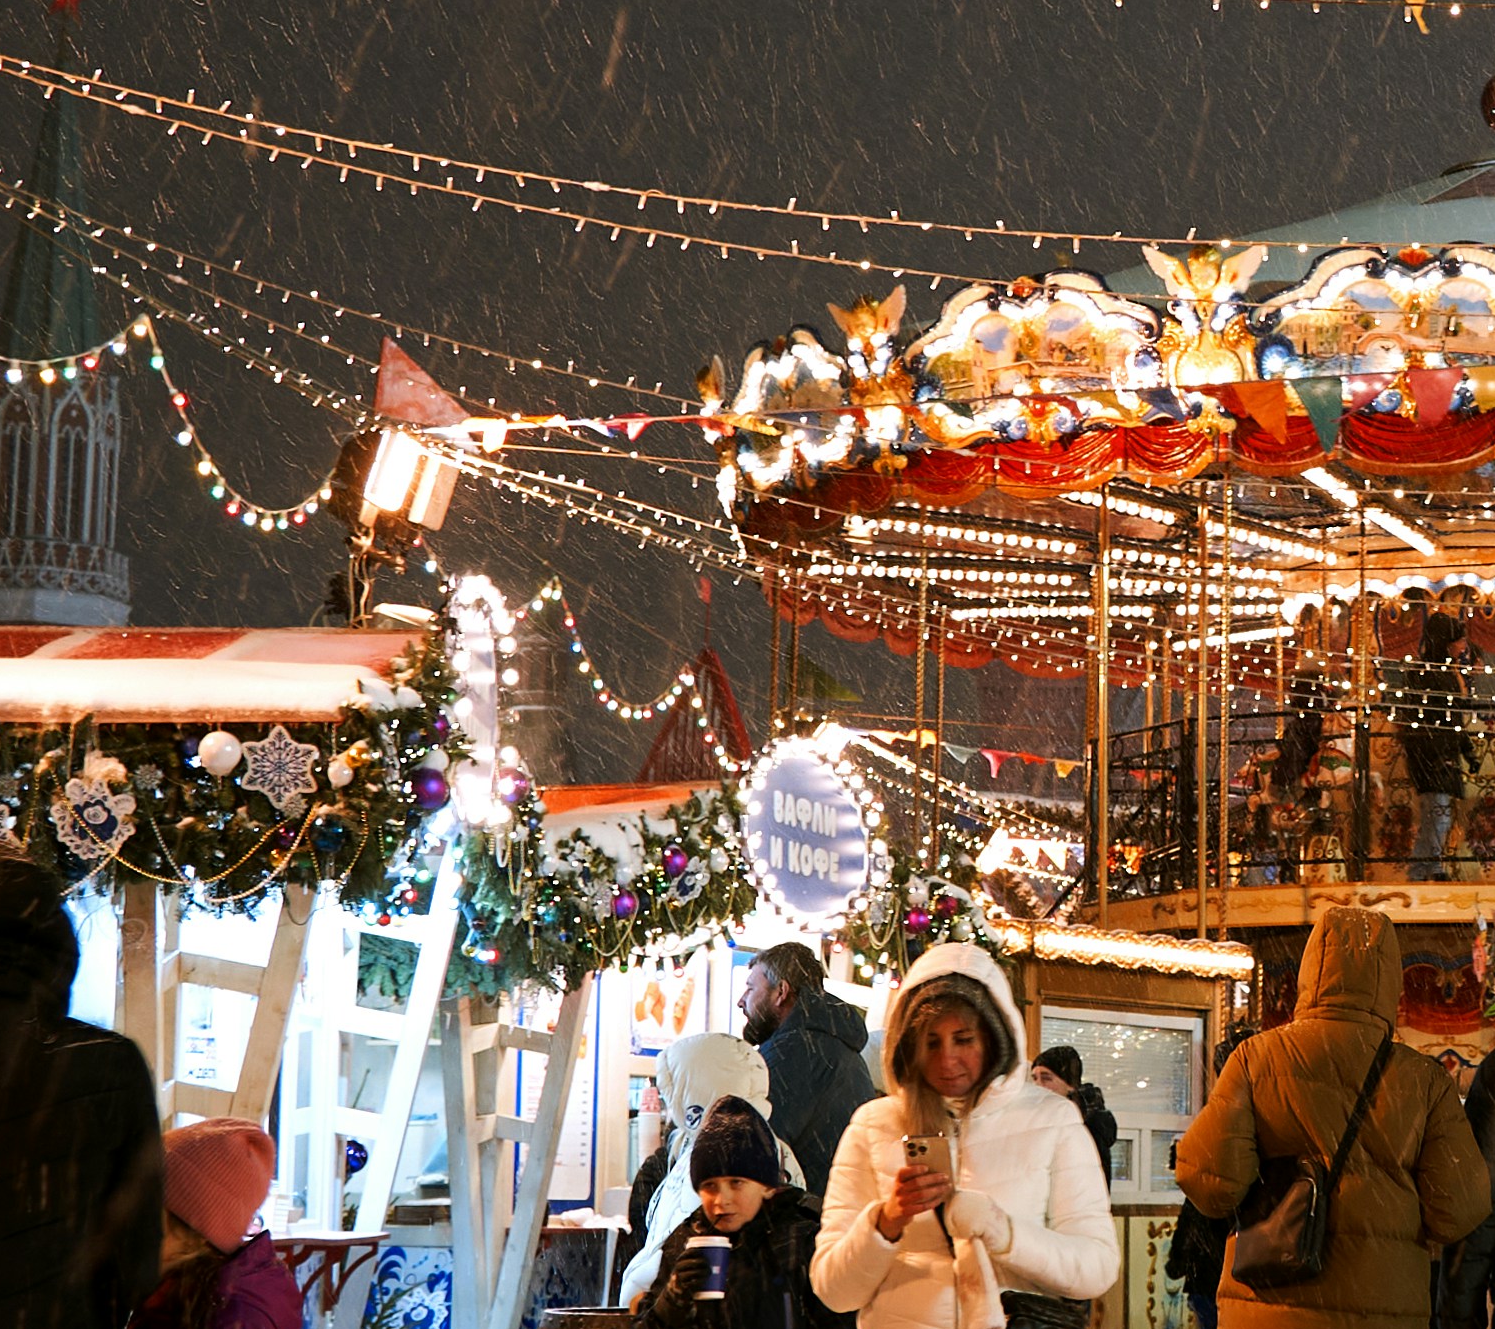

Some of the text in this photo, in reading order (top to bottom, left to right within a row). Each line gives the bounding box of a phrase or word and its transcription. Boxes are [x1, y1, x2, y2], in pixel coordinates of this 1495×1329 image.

[772, 790, 838, 839] ВАФЛИ
[769, 835, 840, 883] И КОФЕ
